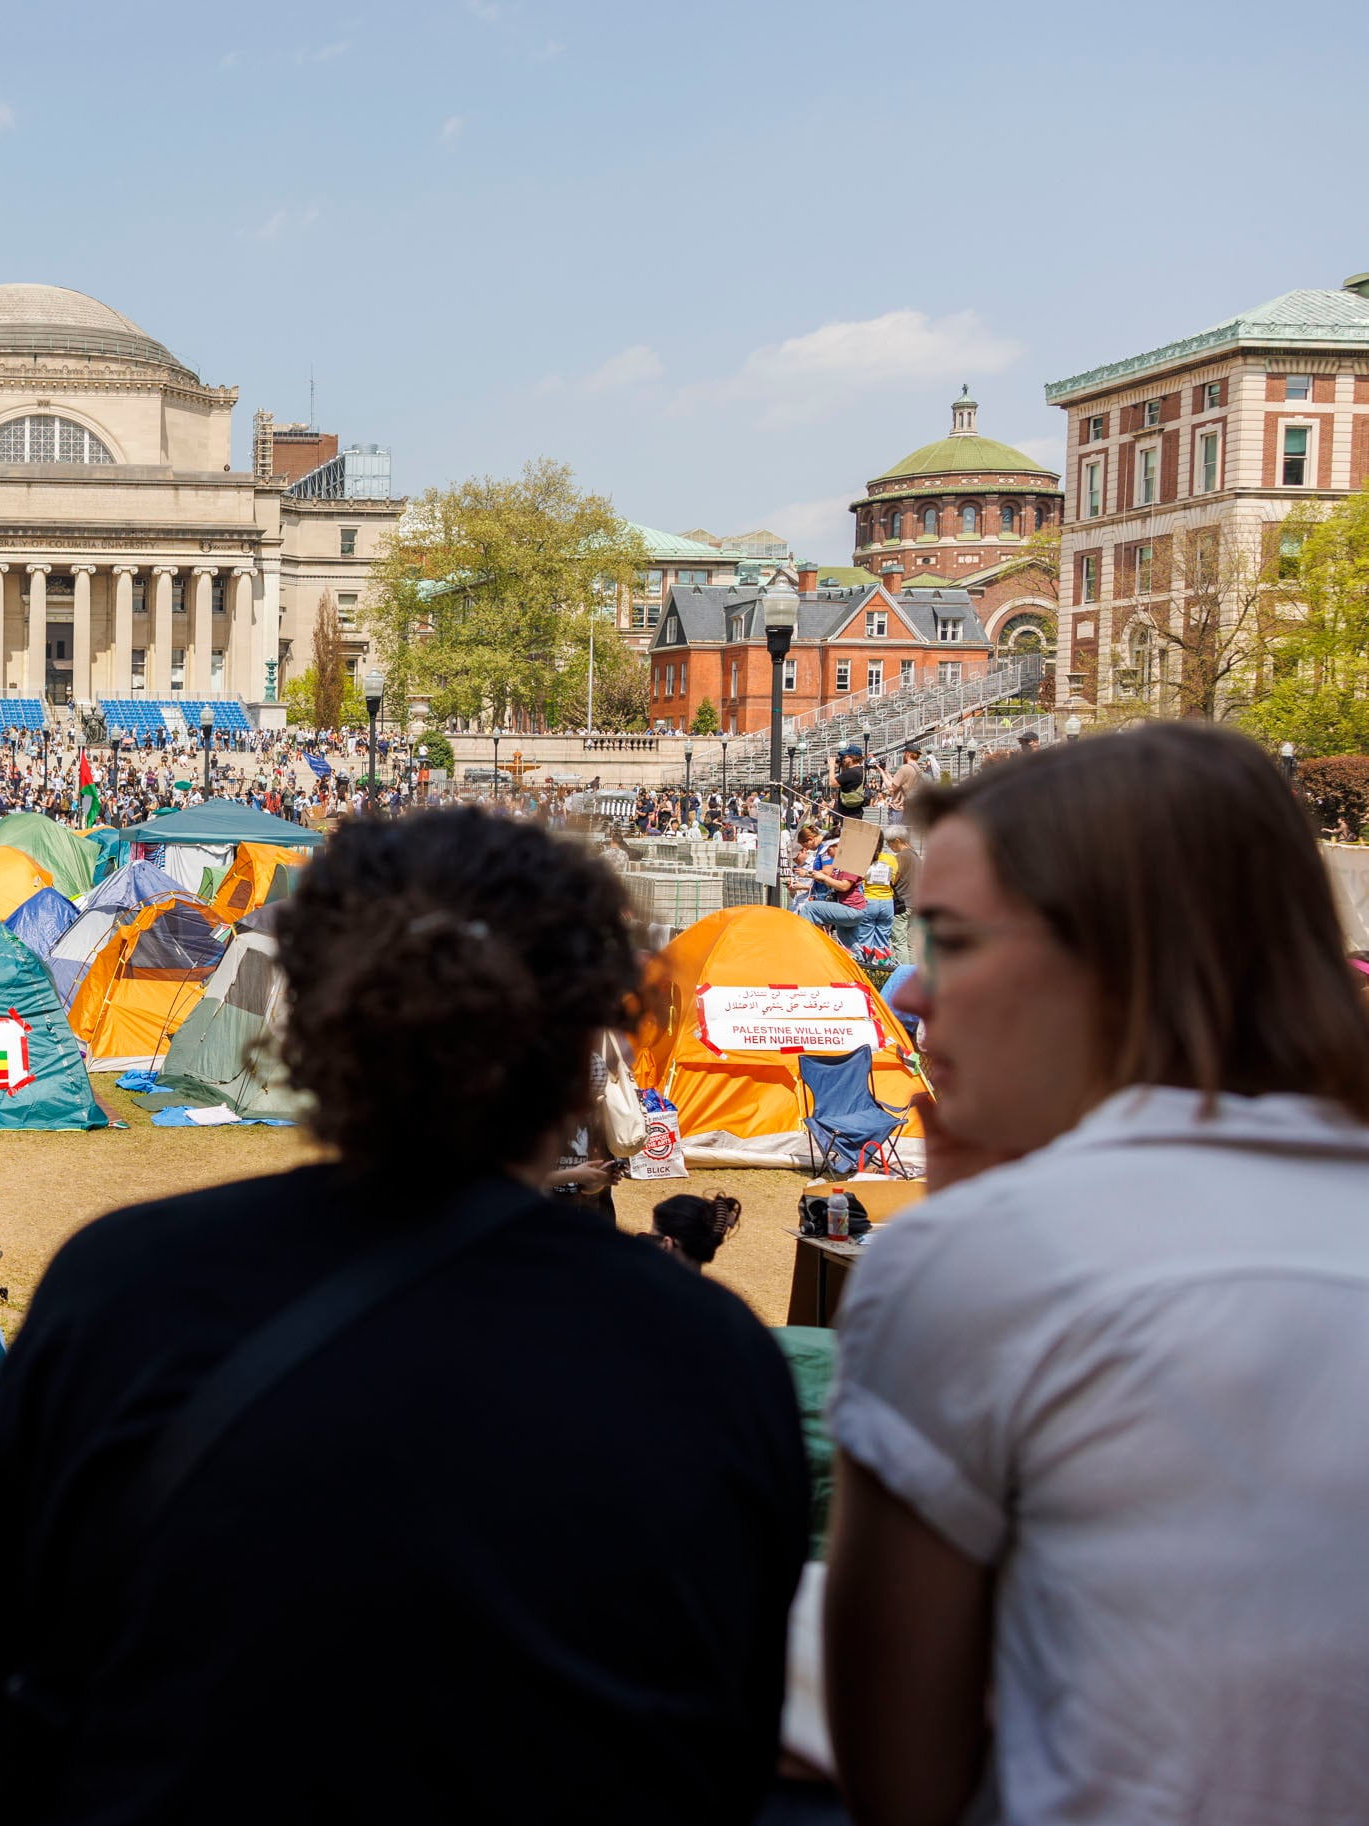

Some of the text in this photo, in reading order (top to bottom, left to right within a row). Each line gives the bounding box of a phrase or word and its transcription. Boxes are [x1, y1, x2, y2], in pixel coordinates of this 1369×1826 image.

[32, 539, 46, 548] OF
[48, 539, 97, 549] COLUMBIA
[101, 540, 156, 550] UNIVERSITY
[732, 1025, 854, 1036] PALESTINE WILL HAVE
[744, 1035, 845, 1045] HER NUREMBERG!
[646, 1166, 671, 1174] BLICK
